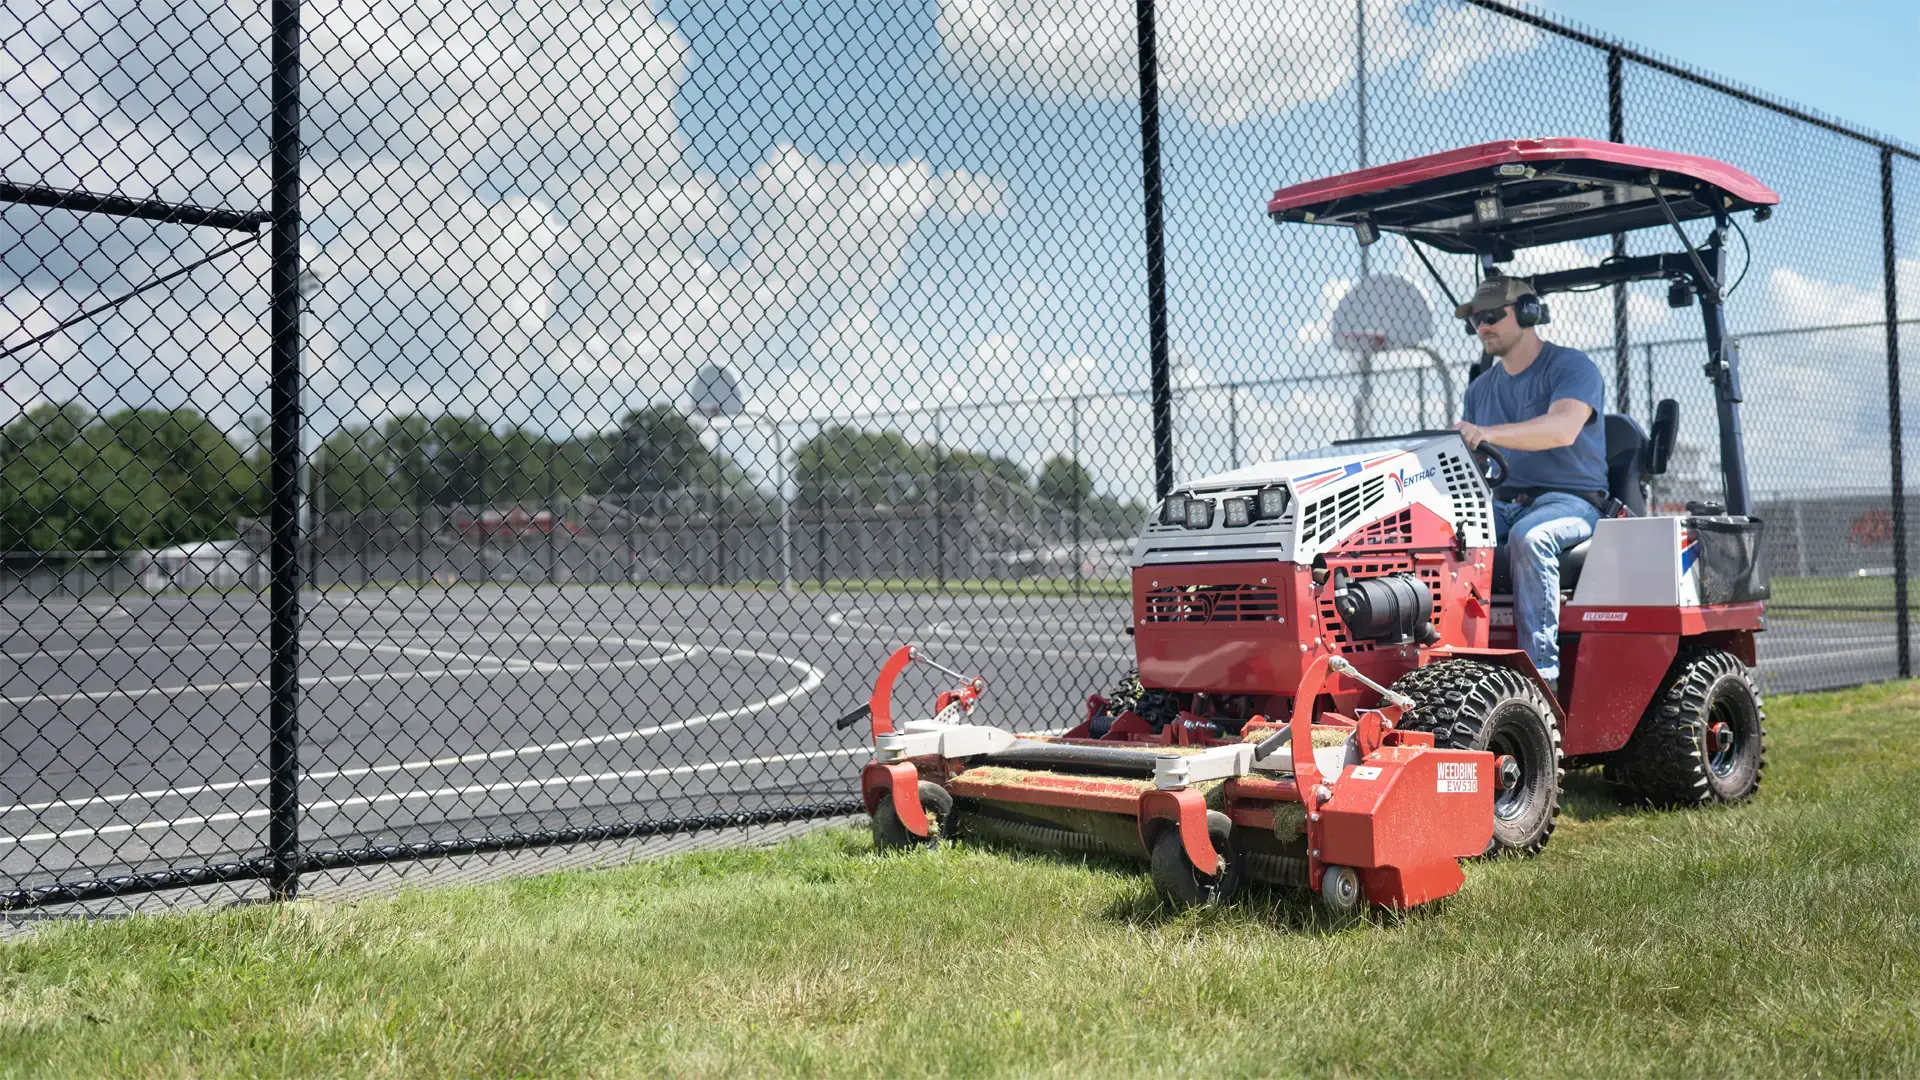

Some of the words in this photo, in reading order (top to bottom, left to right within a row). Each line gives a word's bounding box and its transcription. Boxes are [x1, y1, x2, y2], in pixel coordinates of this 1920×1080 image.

[1389, 467, 1436, 499] VENTRAC
[1585, 612, 1625, 620] FLEXFRAME
[1437, 763, 1478, 779] WEEDBINE
[1446, 781, 1477, 791] EW530
